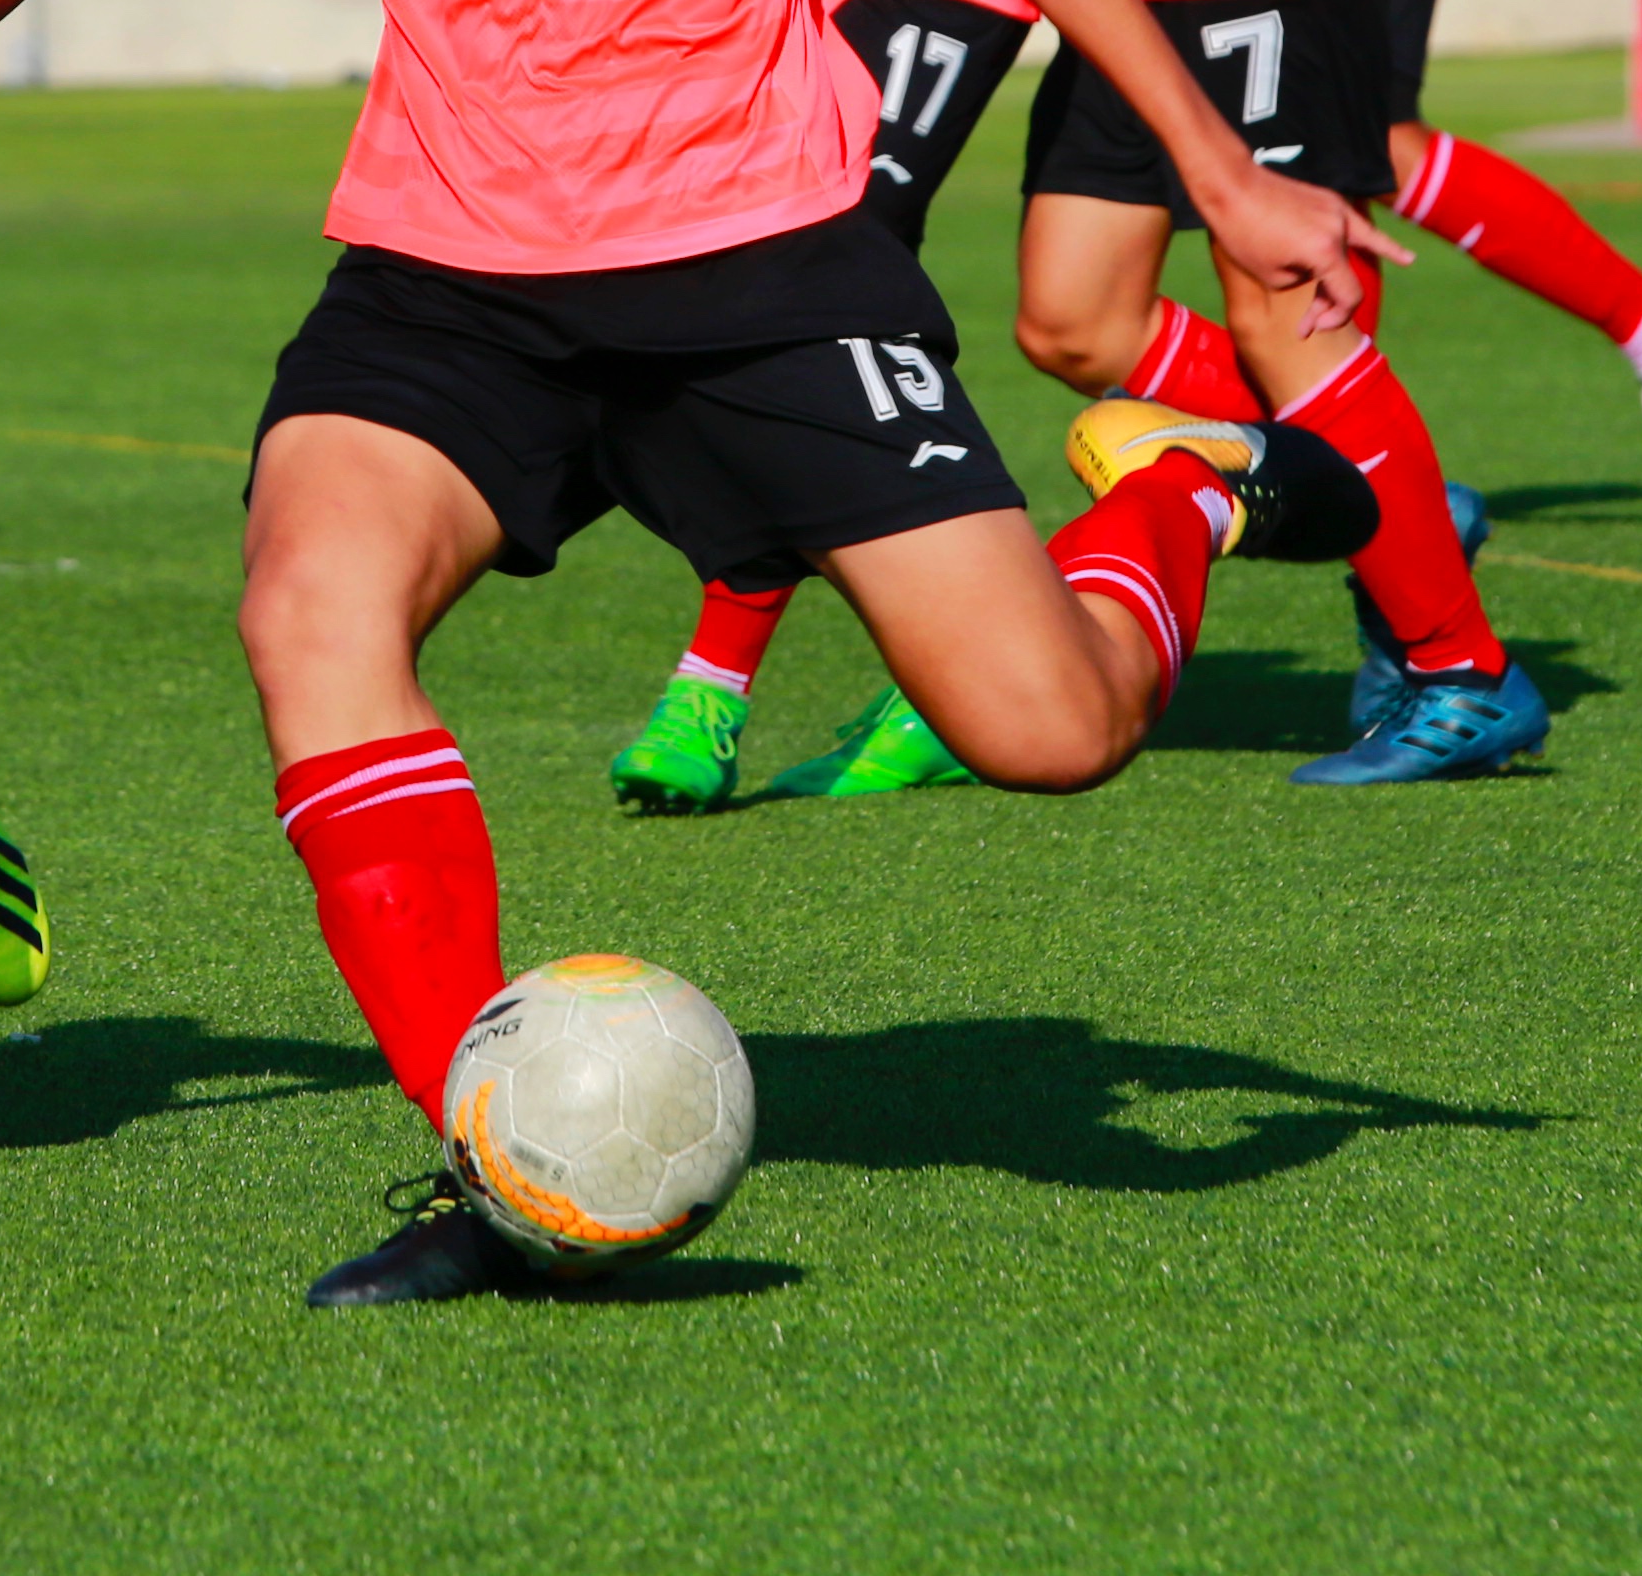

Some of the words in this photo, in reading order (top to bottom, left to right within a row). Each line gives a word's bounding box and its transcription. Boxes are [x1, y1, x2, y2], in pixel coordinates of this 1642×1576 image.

[879, 23, 968, 137] 17
[1201, 9, 1284, 124] 7
[837, 332, 945, 422] 15
